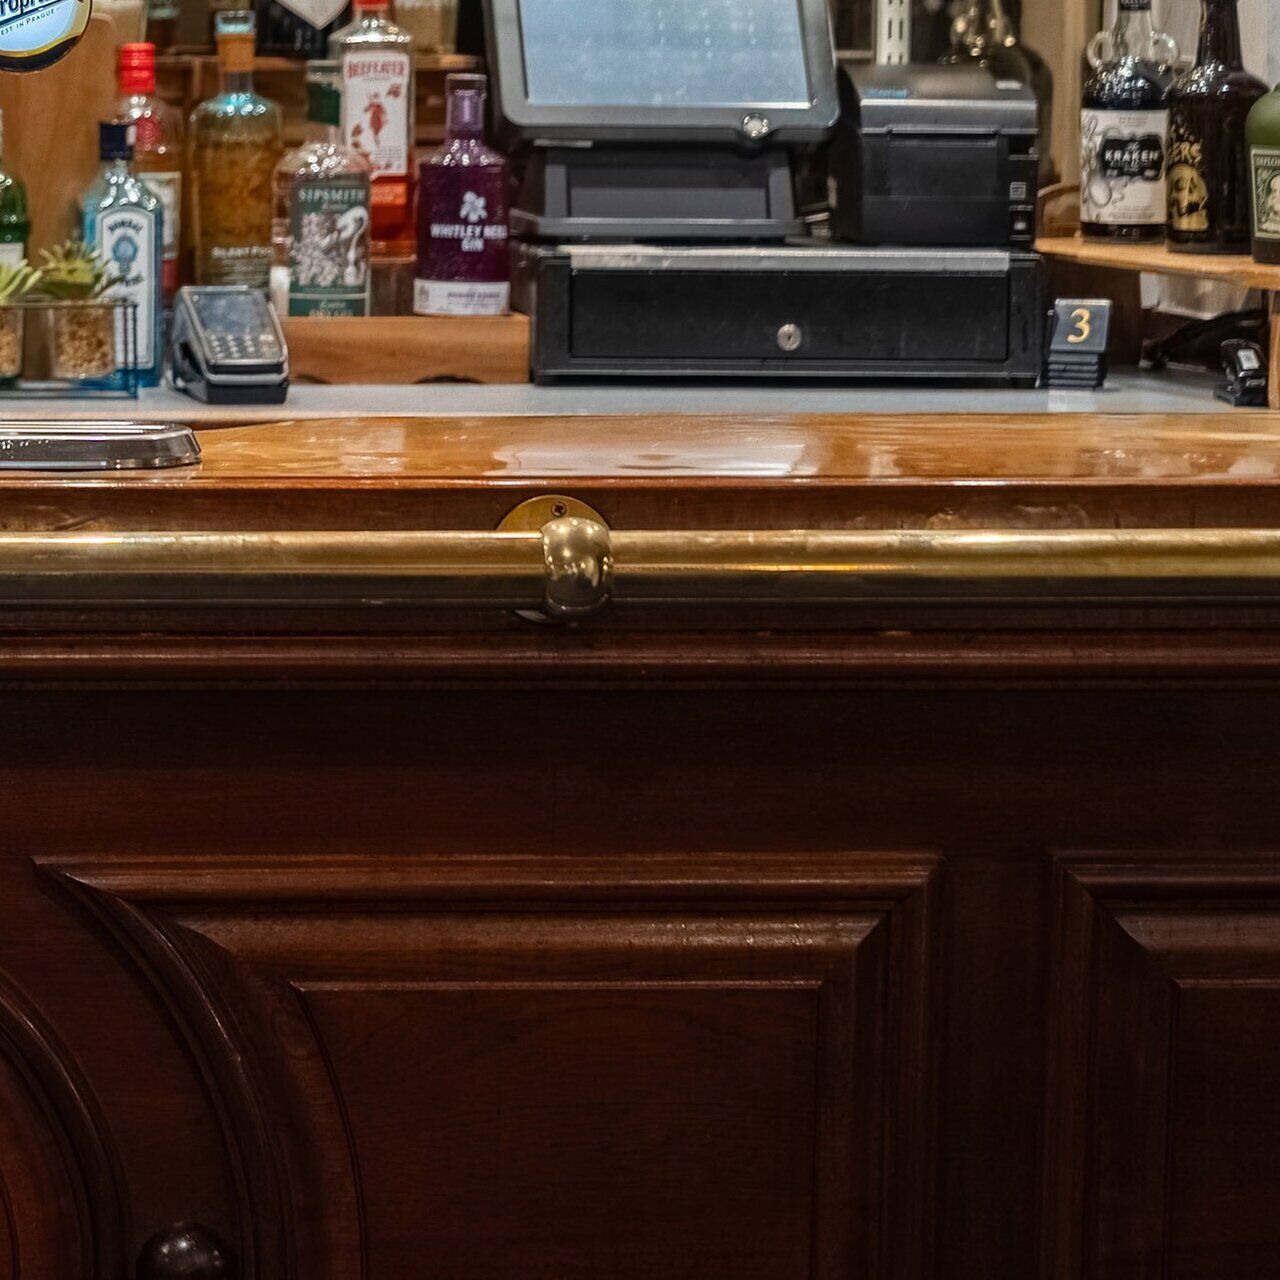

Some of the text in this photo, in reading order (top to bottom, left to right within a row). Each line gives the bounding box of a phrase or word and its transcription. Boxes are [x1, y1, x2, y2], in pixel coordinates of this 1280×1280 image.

[26, 7, 55, 25] PRAGUE
[1104, 149, 1159, 162] KRAKEN
[298, 188, 366, 202] SIPSMITH
[430, 224, 482, 239] WHITLEY
[461, 238, 485, 251] GIN
[1068, 309, 1091, 344] 3
